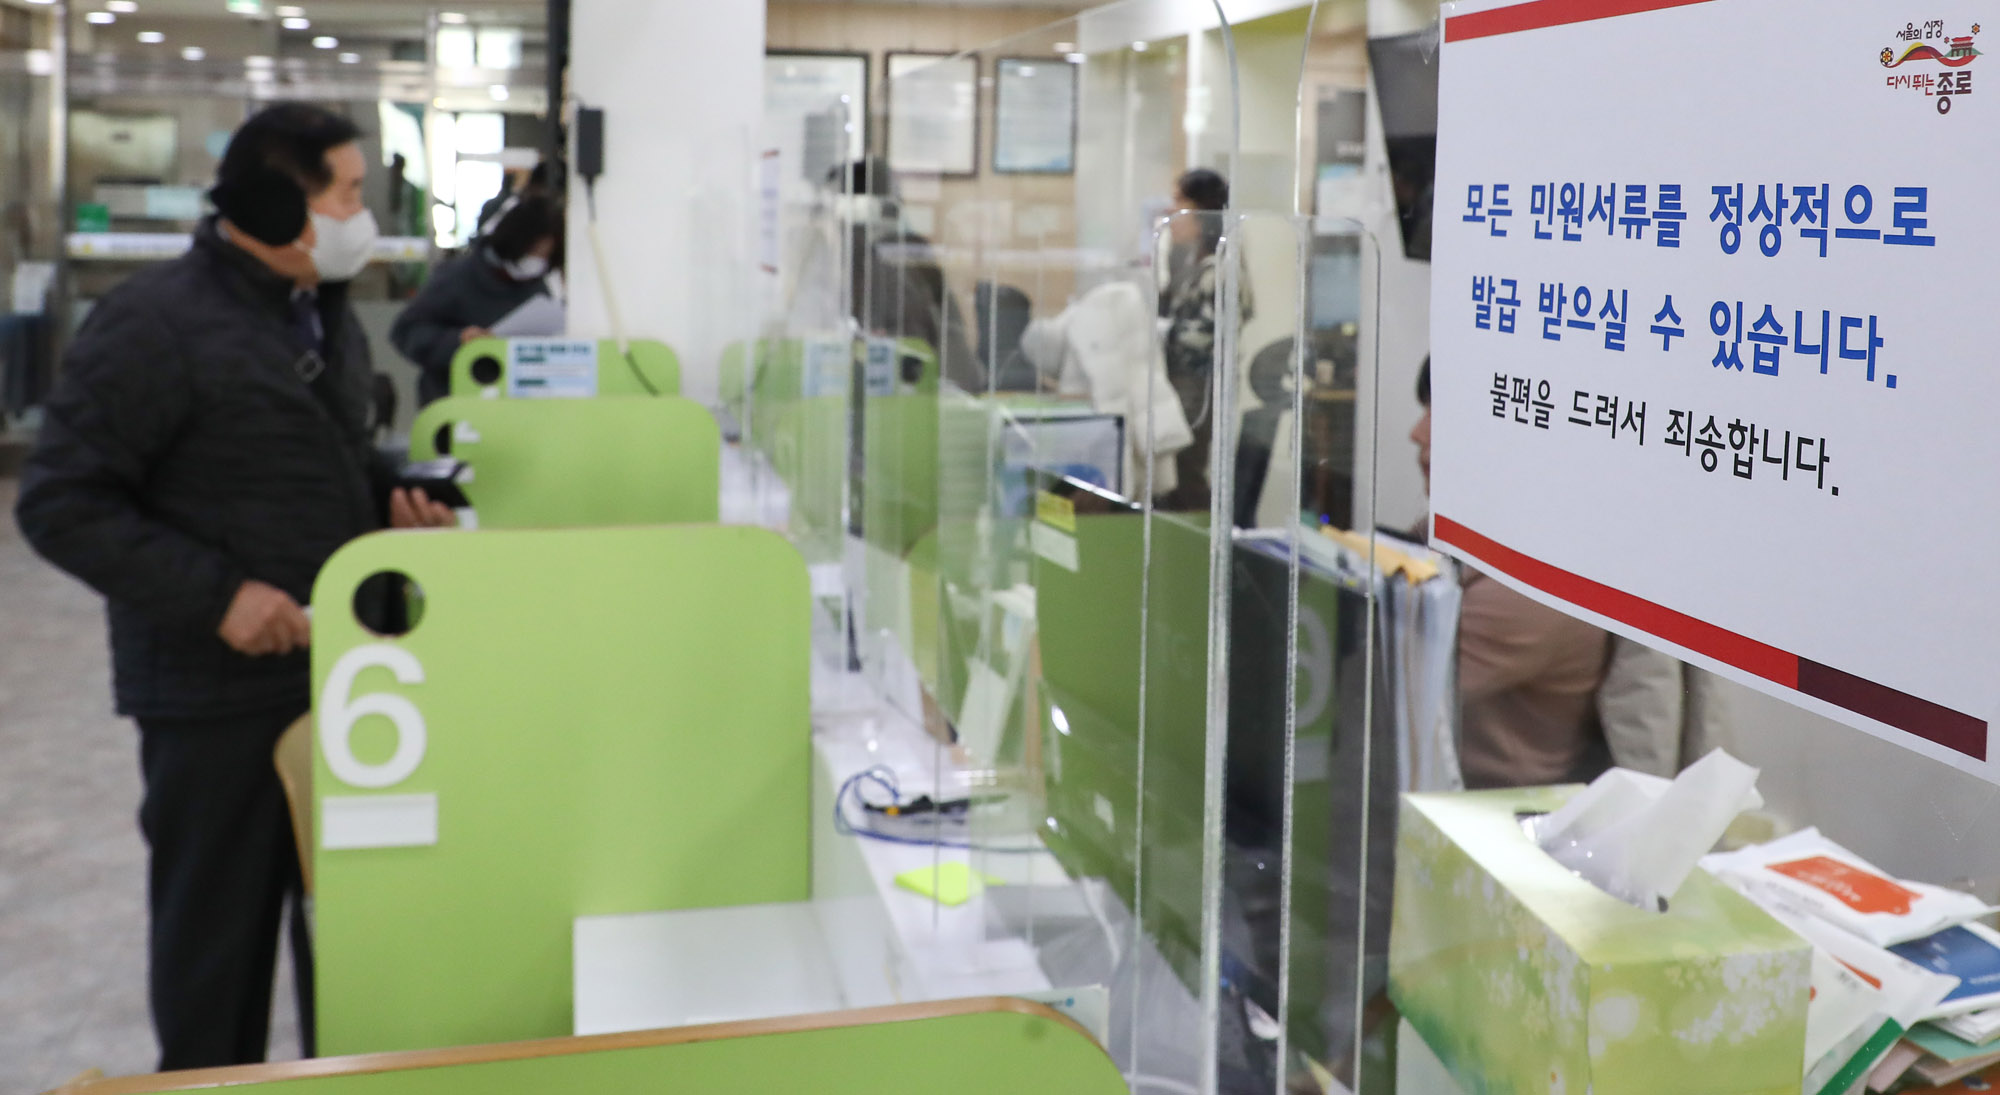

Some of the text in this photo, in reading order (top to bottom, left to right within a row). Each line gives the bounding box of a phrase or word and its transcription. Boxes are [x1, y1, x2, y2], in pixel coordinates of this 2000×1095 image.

[1895, 19, 1944, 41] 서울의 심장
[1886, 71, 1972, 115] 다시 뛰는 종로
[1462, 182, 1936, 258] 모든 민원서류를 정상적으로
[1472, 275, 1897, 389] 발급 받으실 수 있습니다.
[1489, 372, 1839, 496] 불편을 드려서 죄송합니다.
[319, 644, 427, 788] 6
